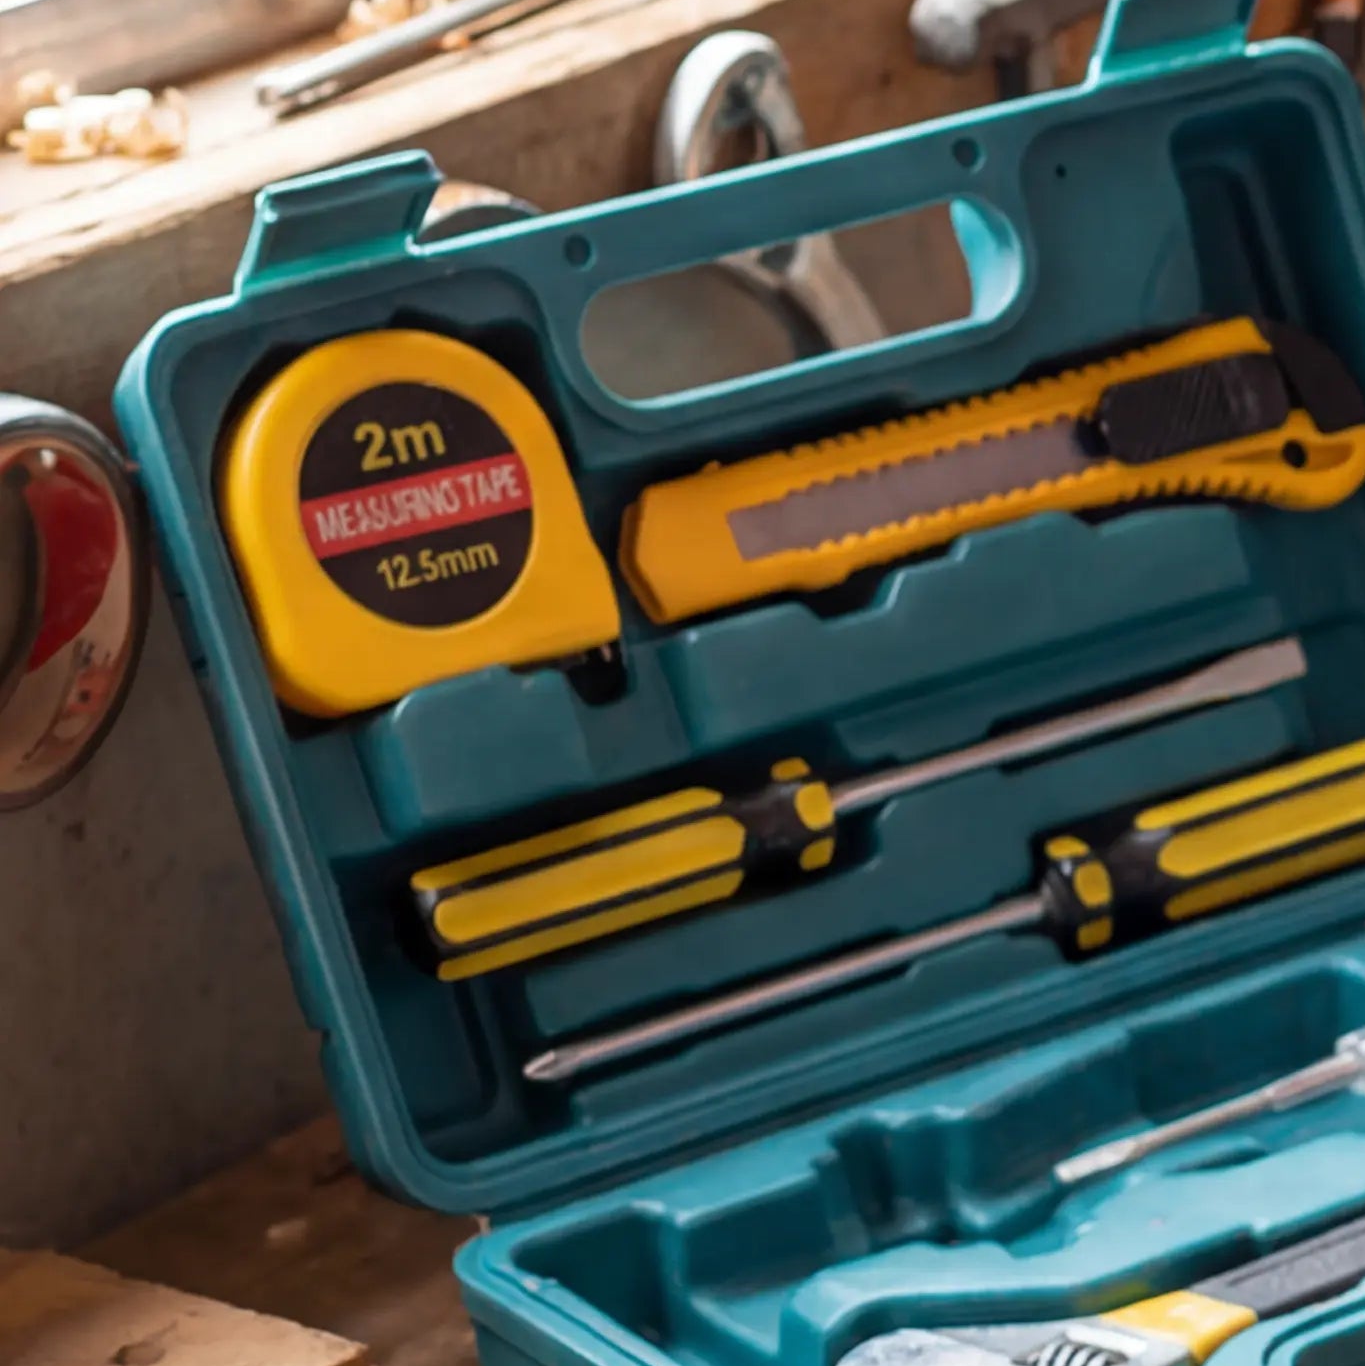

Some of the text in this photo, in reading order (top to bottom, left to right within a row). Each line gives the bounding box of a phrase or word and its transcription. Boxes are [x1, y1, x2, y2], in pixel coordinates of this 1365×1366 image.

[354, 421, 446, 471] 2m
[458, 464, 522, 507] TAPE
[377, 542, 499, 591] 12.5mm
